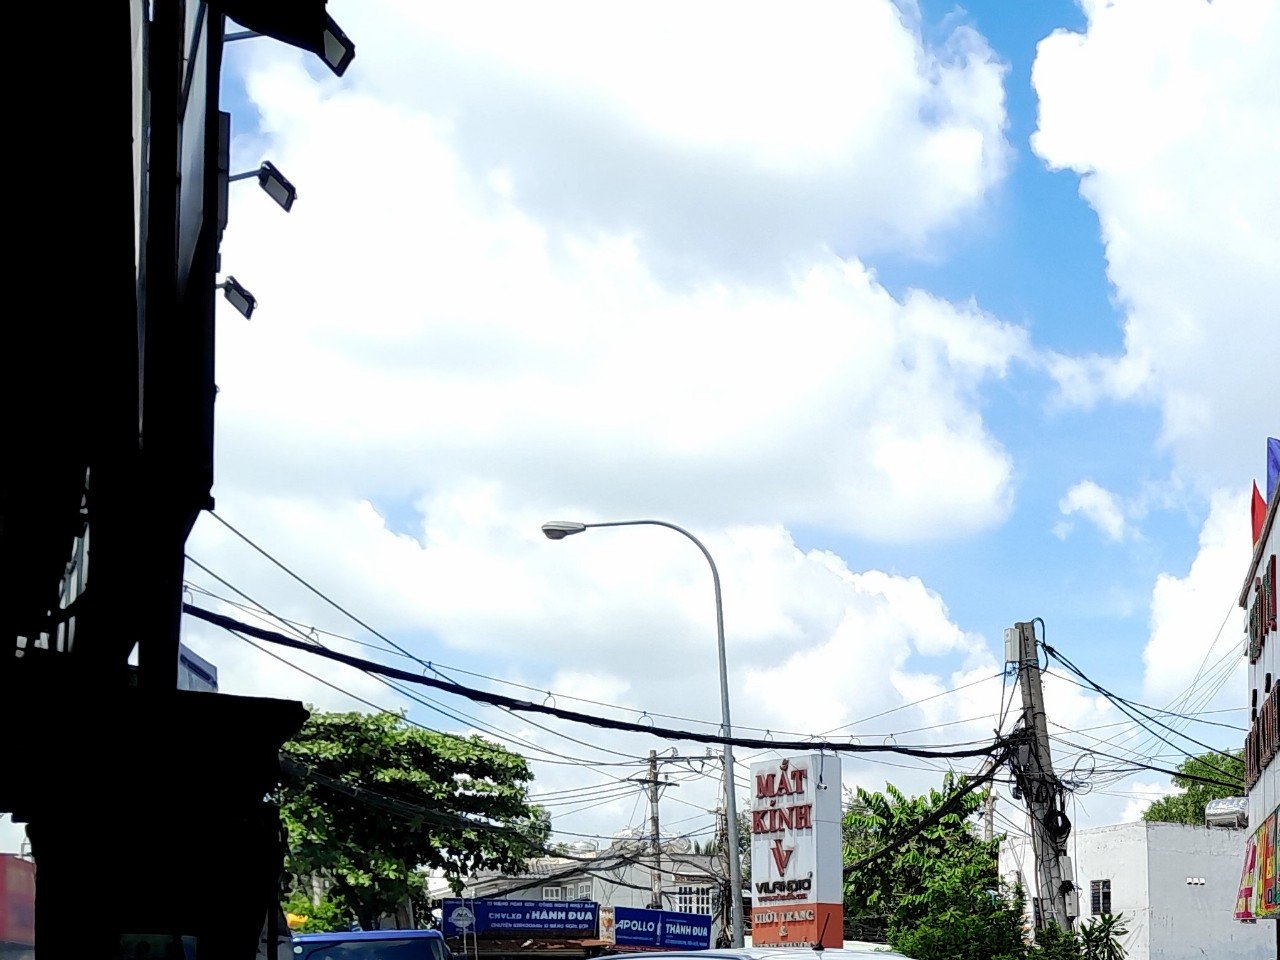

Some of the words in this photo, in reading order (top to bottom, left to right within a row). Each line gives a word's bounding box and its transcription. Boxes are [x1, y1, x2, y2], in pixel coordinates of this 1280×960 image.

[756, 759, 807, 799] MẮT
[752, 800, 812, 834] KÍNH
[615, 919, 655, 932] APOLLO
[666, 922, 692, 936] THÀNH
[692, 926, 708, 937] ĐUA
